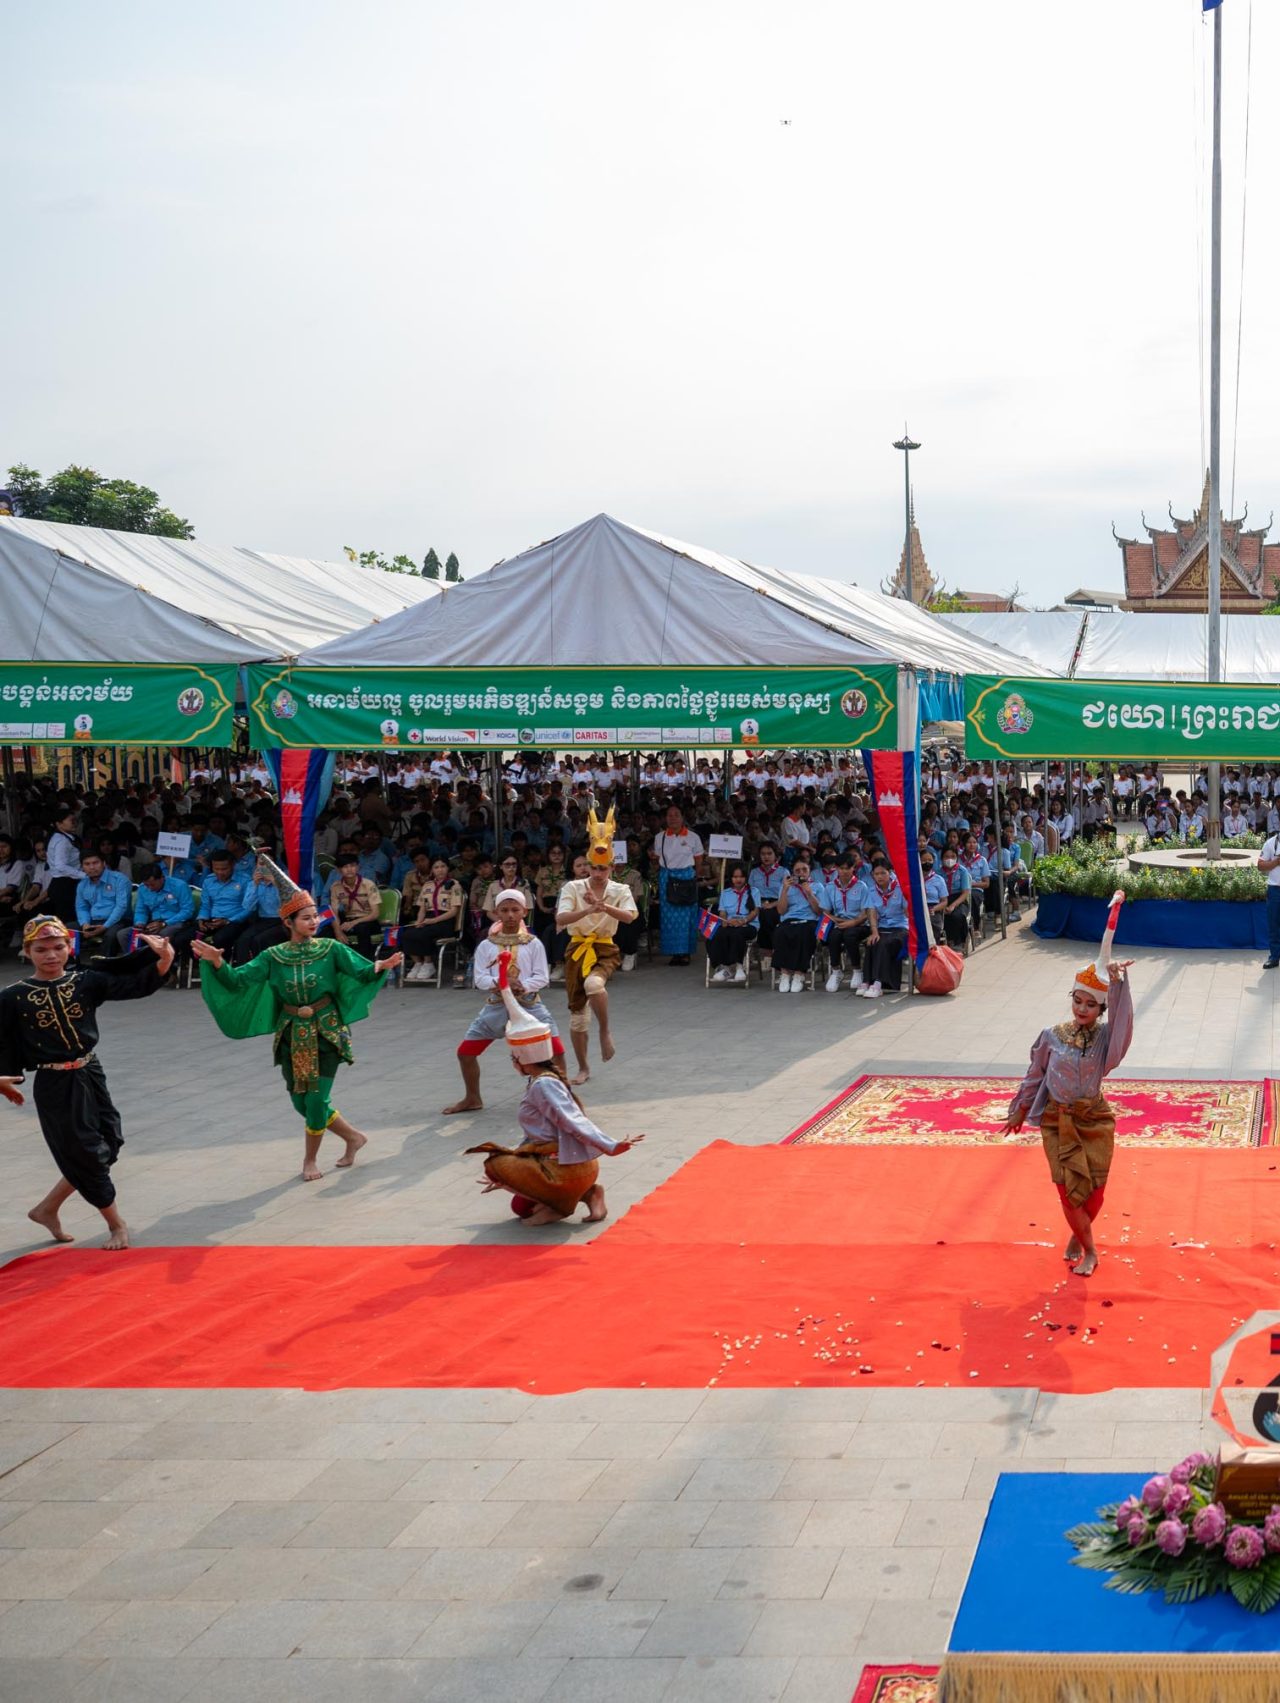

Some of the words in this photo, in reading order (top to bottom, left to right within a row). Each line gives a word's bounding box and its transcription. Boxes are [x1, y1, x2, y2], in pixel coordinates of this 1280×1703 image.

[0, 676, 133, 708] បង្គន់អនាម័យ
[307, 686, 402, 716] អនាម័យល្អ
[409, 686, 604, 716] ចូលរួមអភិវឌ្ឍន៍សង្គម
[611, 685, 831, 722] និងភាពថ្លៃថ្នូររបស់មនុស្ស
[535, 730, 561, 740] unicef
[575, 731, 608, 740] CARITAS
